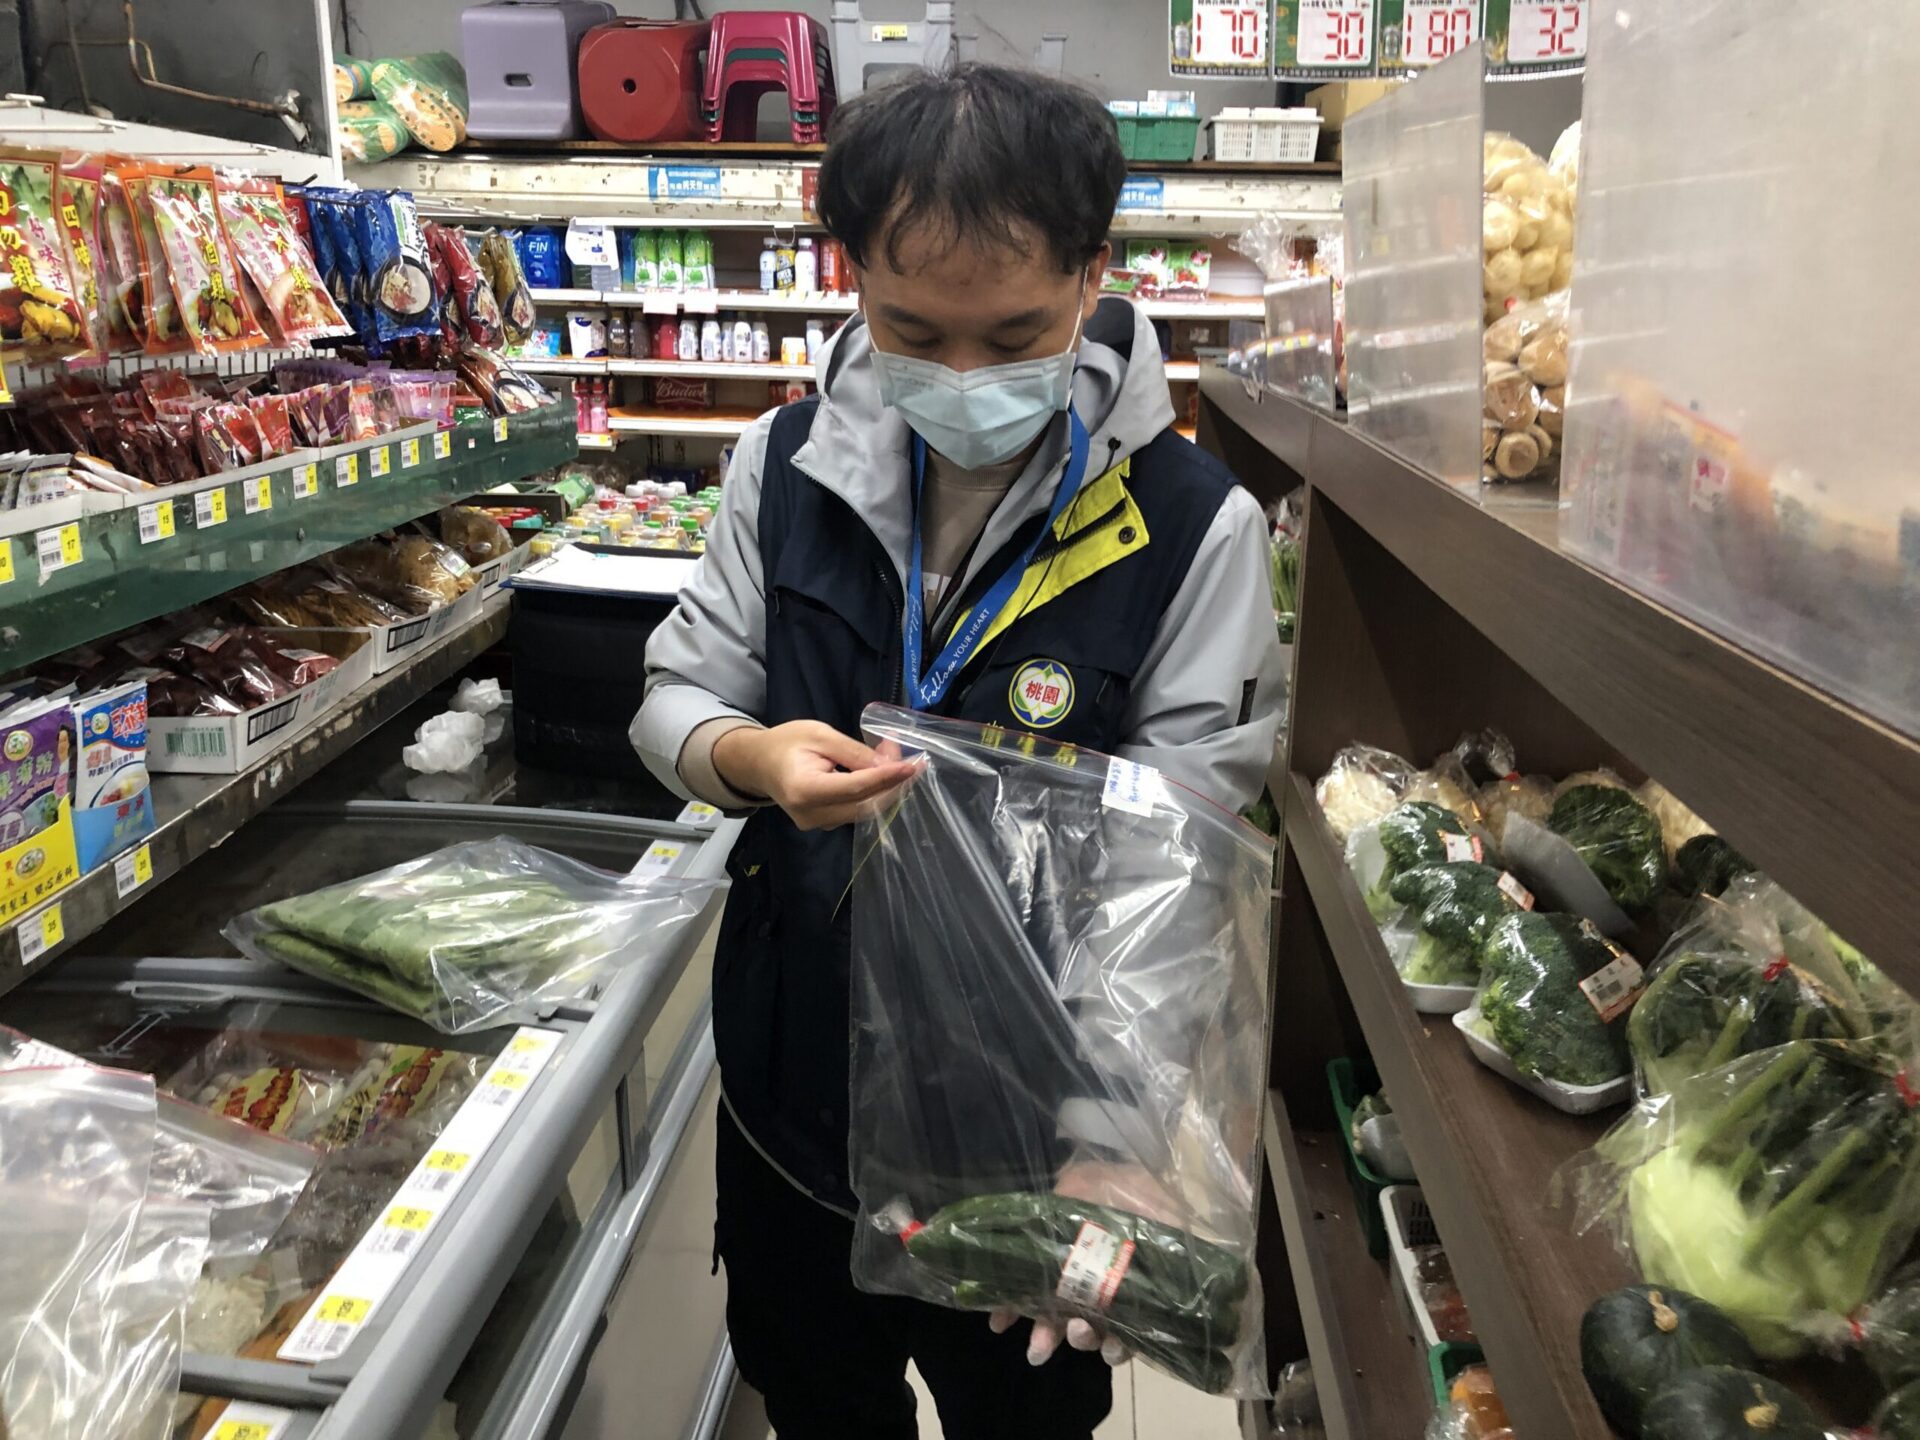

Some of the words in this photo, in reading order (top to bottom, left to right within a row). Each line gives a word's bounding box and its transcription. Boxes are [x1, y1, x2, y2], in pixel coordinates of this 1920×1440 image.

[1324, 12, 1364, 60] 30
[1537, 6, 1580, 56] 32
[528, 241, 548, 253] FIN
[67, 538, 76, 550] 17
[920, 660, 958, 705] Follow
[953, 634, 973, 660] YOUR
[969, 607, 991, 636] HEART
[1025, 680, 1061, 706] 桃園
